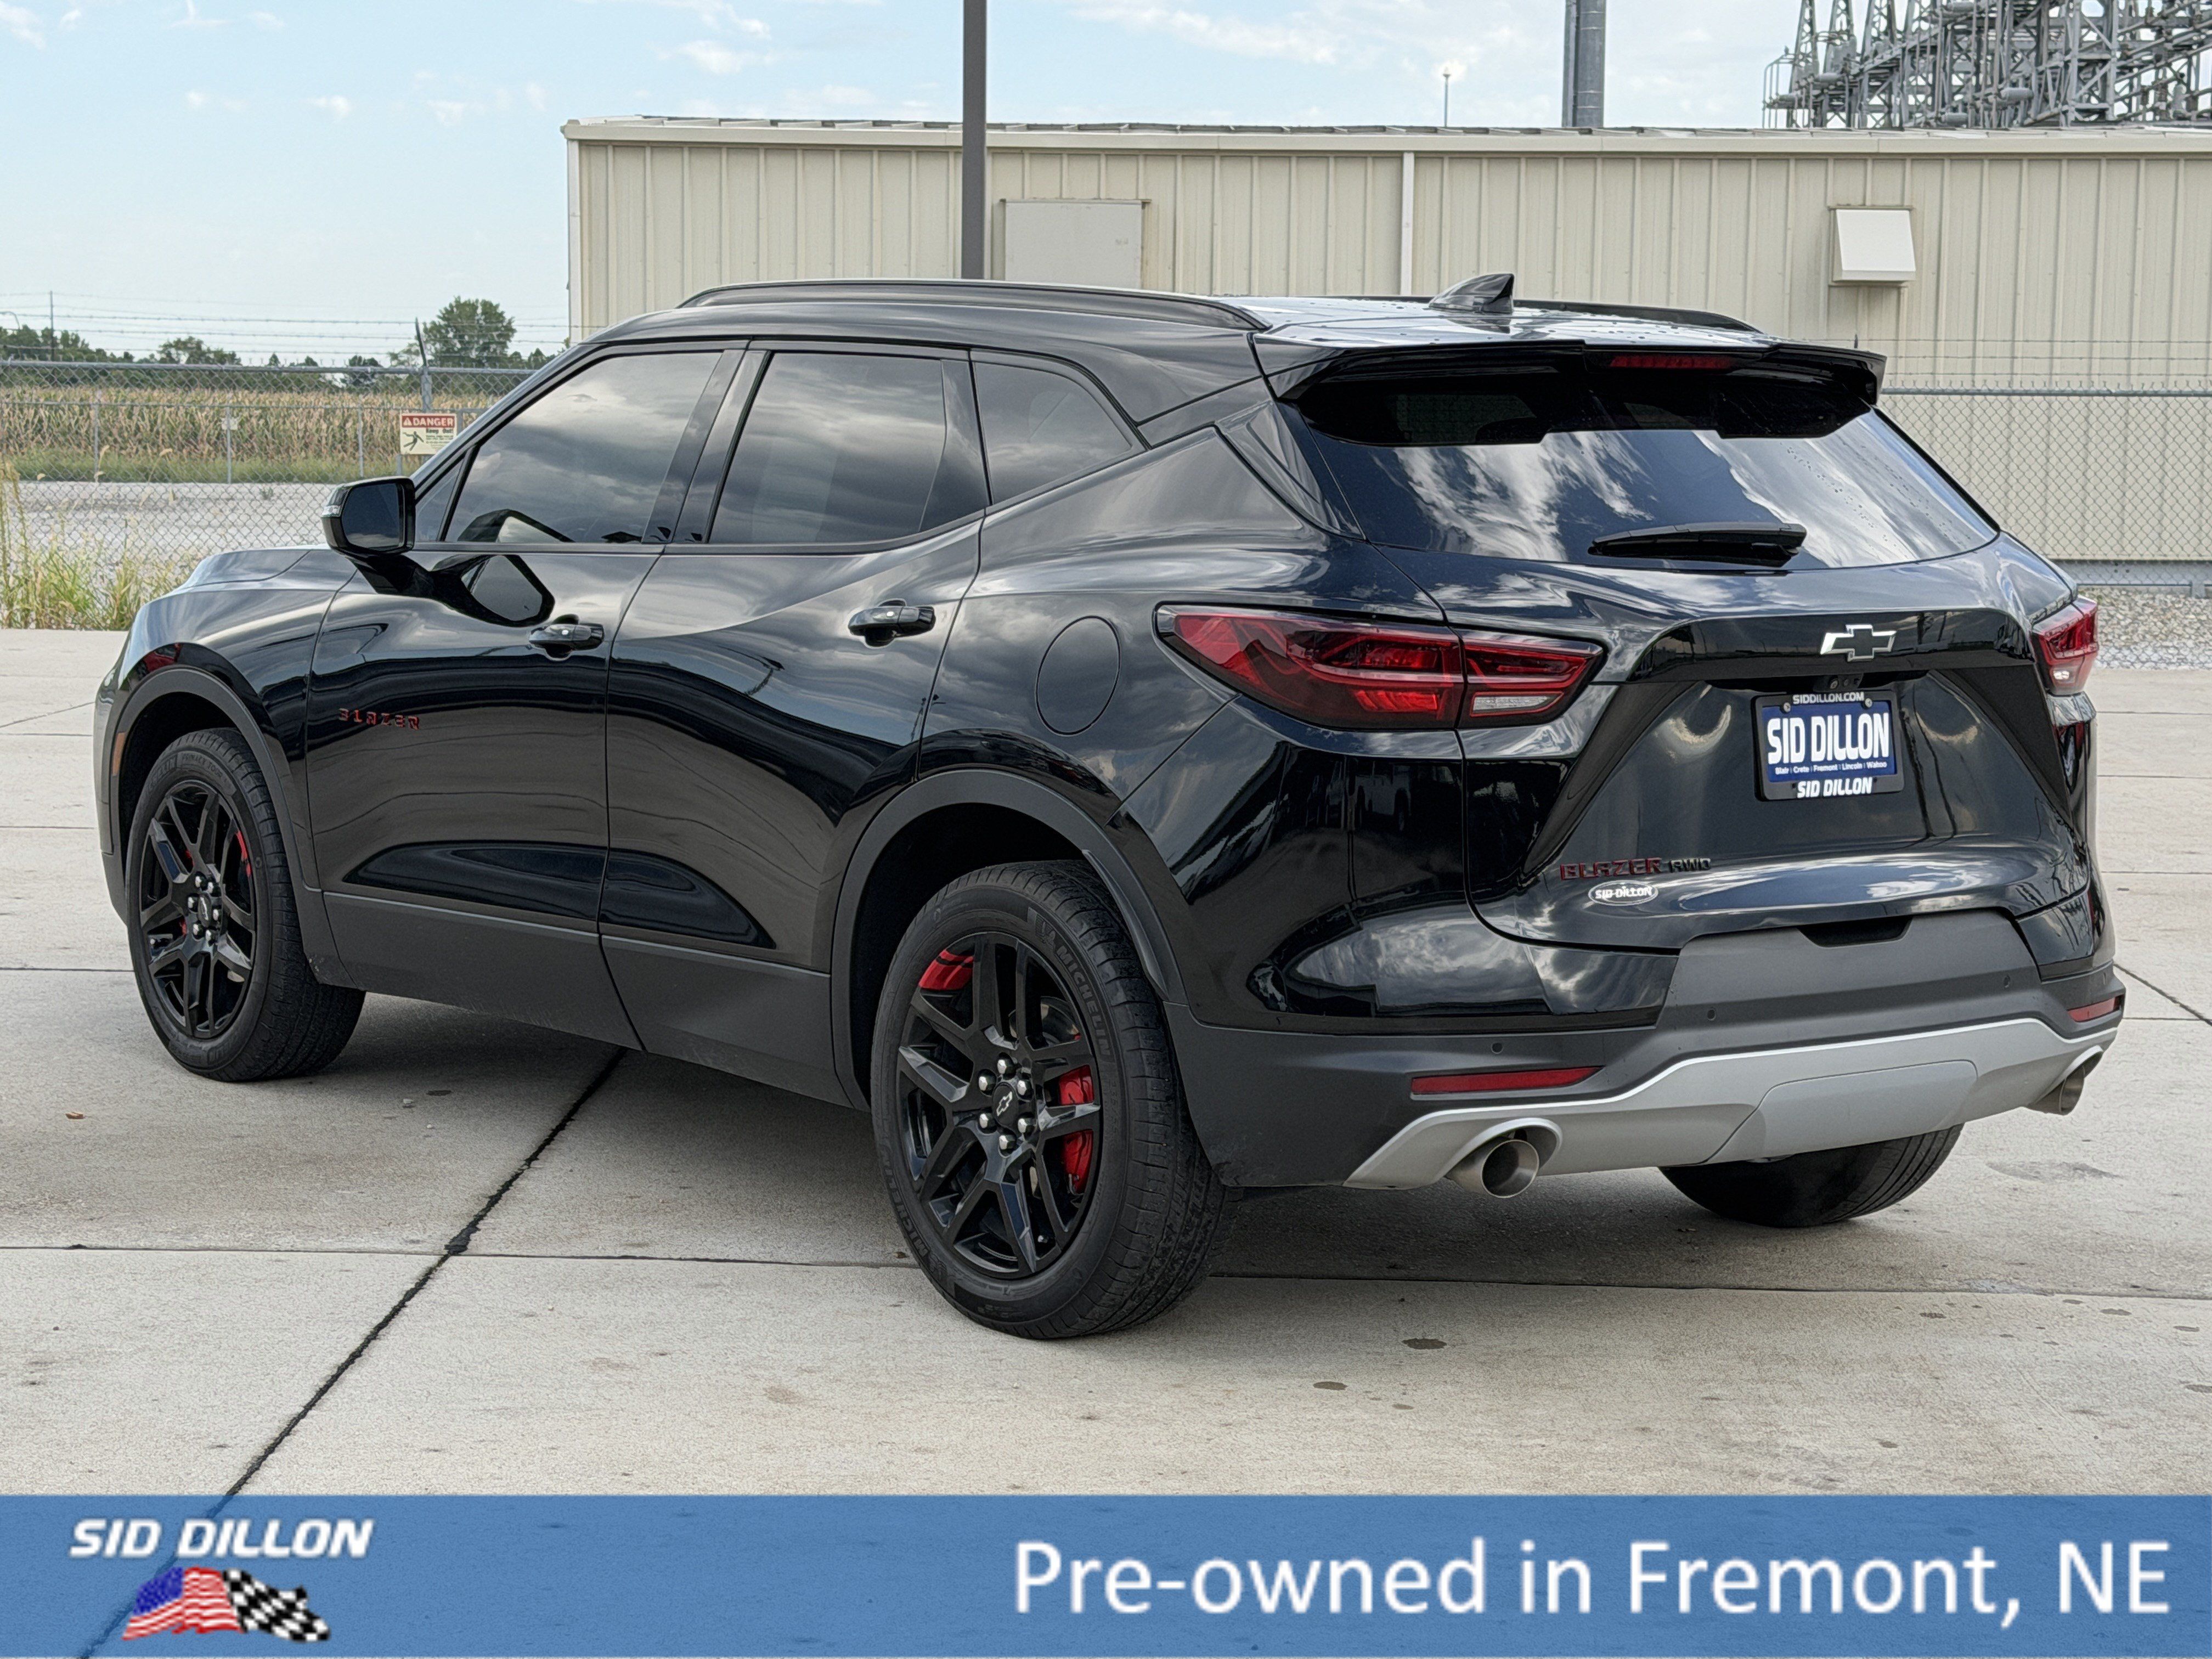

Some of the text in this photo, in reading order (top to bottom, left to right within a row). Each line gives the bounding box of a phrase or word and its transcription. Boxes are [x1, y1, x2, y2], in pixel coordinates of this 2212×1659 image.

[413, 417, 454, 427] DANGER
[1792, 692, 1865, 704] SIDDILLON.COM
[338, 708, 420, 730] BLAZER
[1767, 713, 1889, 764] SID DILLON
[1797, 777, 1873, 798] SID DILLON
[1560, 857, 1662, 880] BLAZER
[1056, 945, 1111, 1056] MICHELIN
